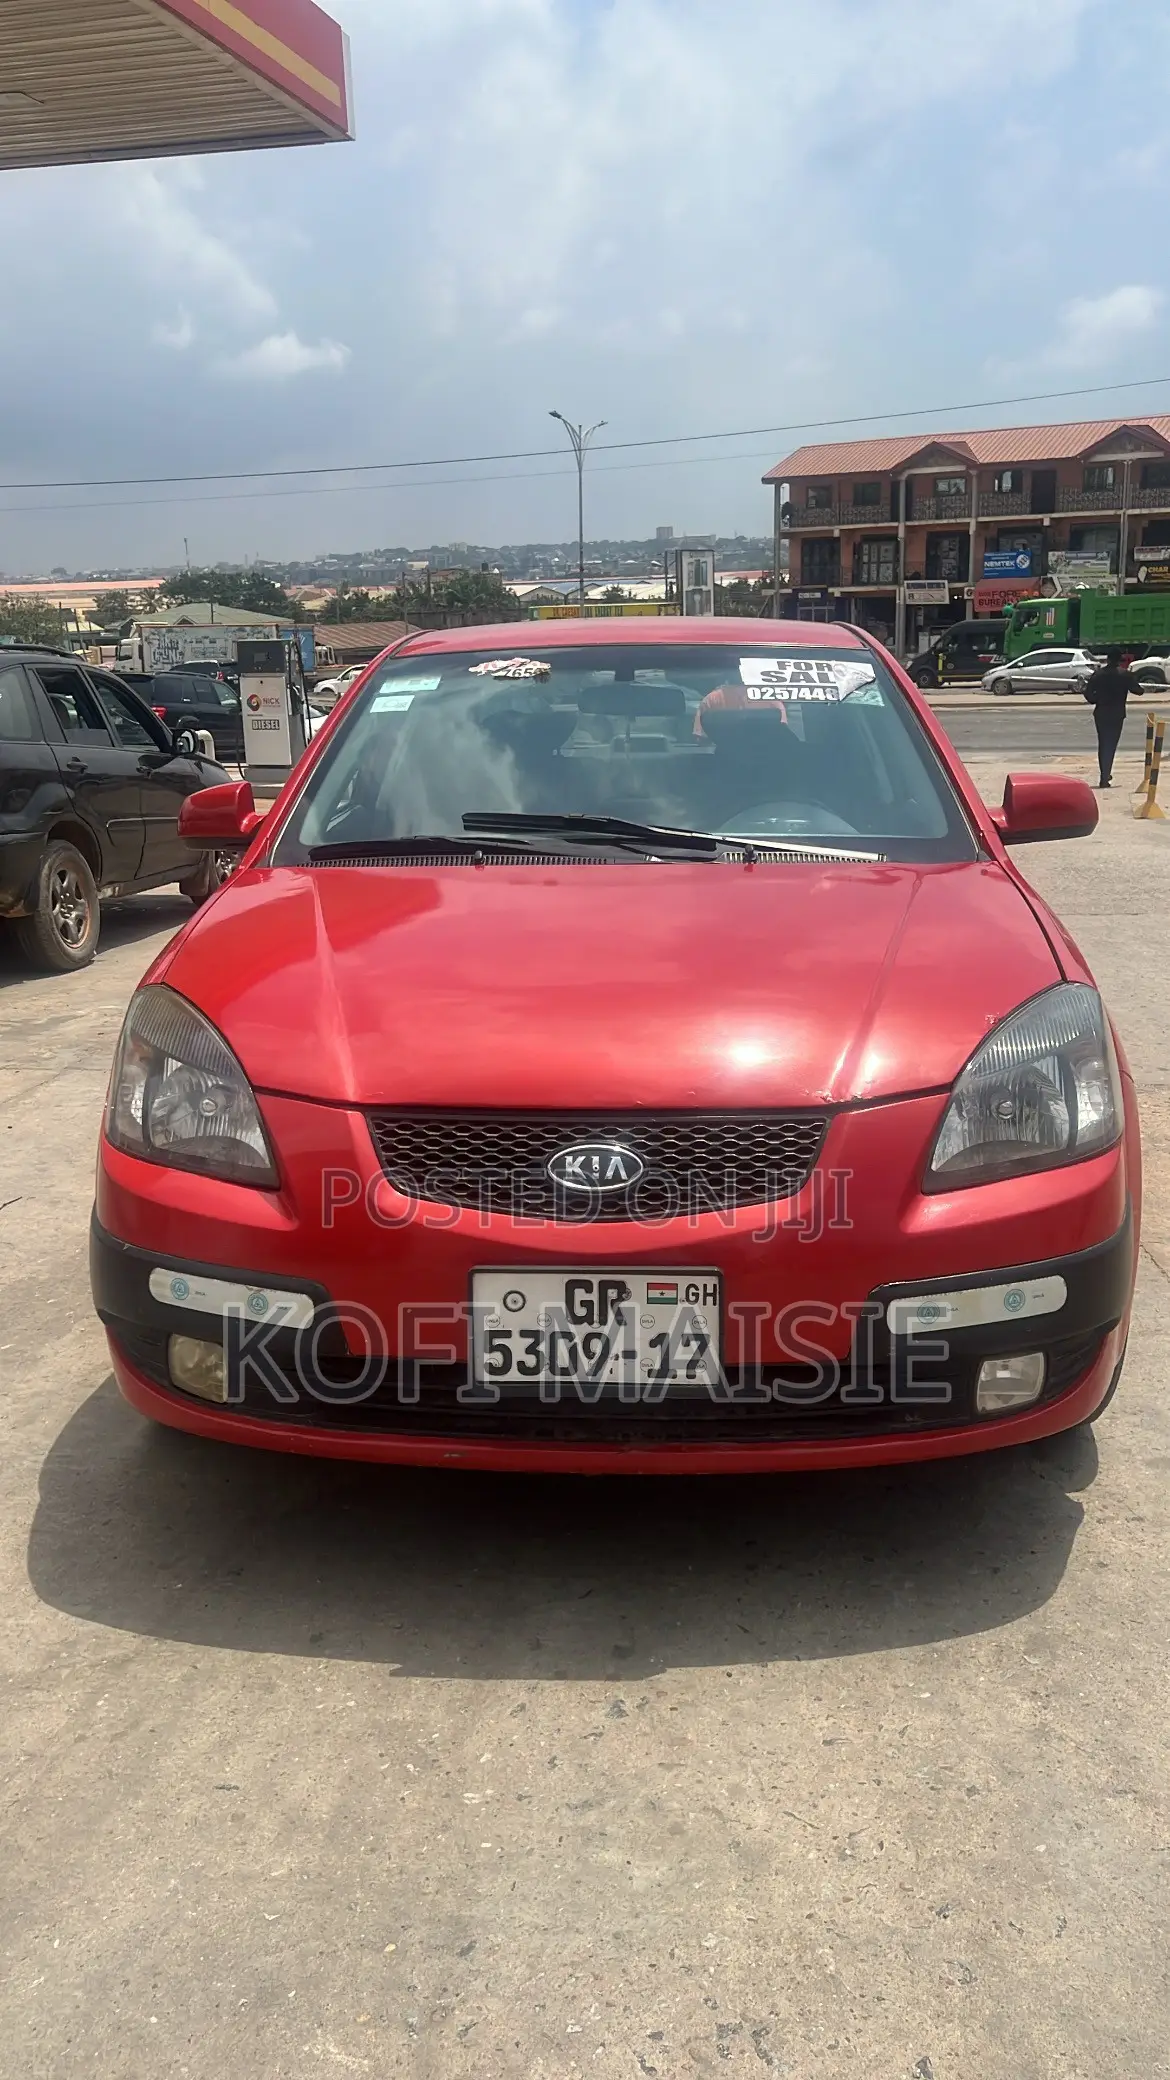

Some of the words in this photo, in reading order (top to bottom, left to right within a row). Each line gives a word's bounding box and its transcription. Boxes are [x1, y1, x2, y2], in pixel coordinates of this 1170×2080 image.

[776, 660, 833, 672] FOR
[760, 670, 837, 684] SAL
[746, 687, 838, 700] 0257448
[252, 720, 279, 730] DIESEL
[564, 1155, 629, 1180] KIA
[684, 1282, 718, 1307] GH
[564, 1278, 628, 1326] GR
